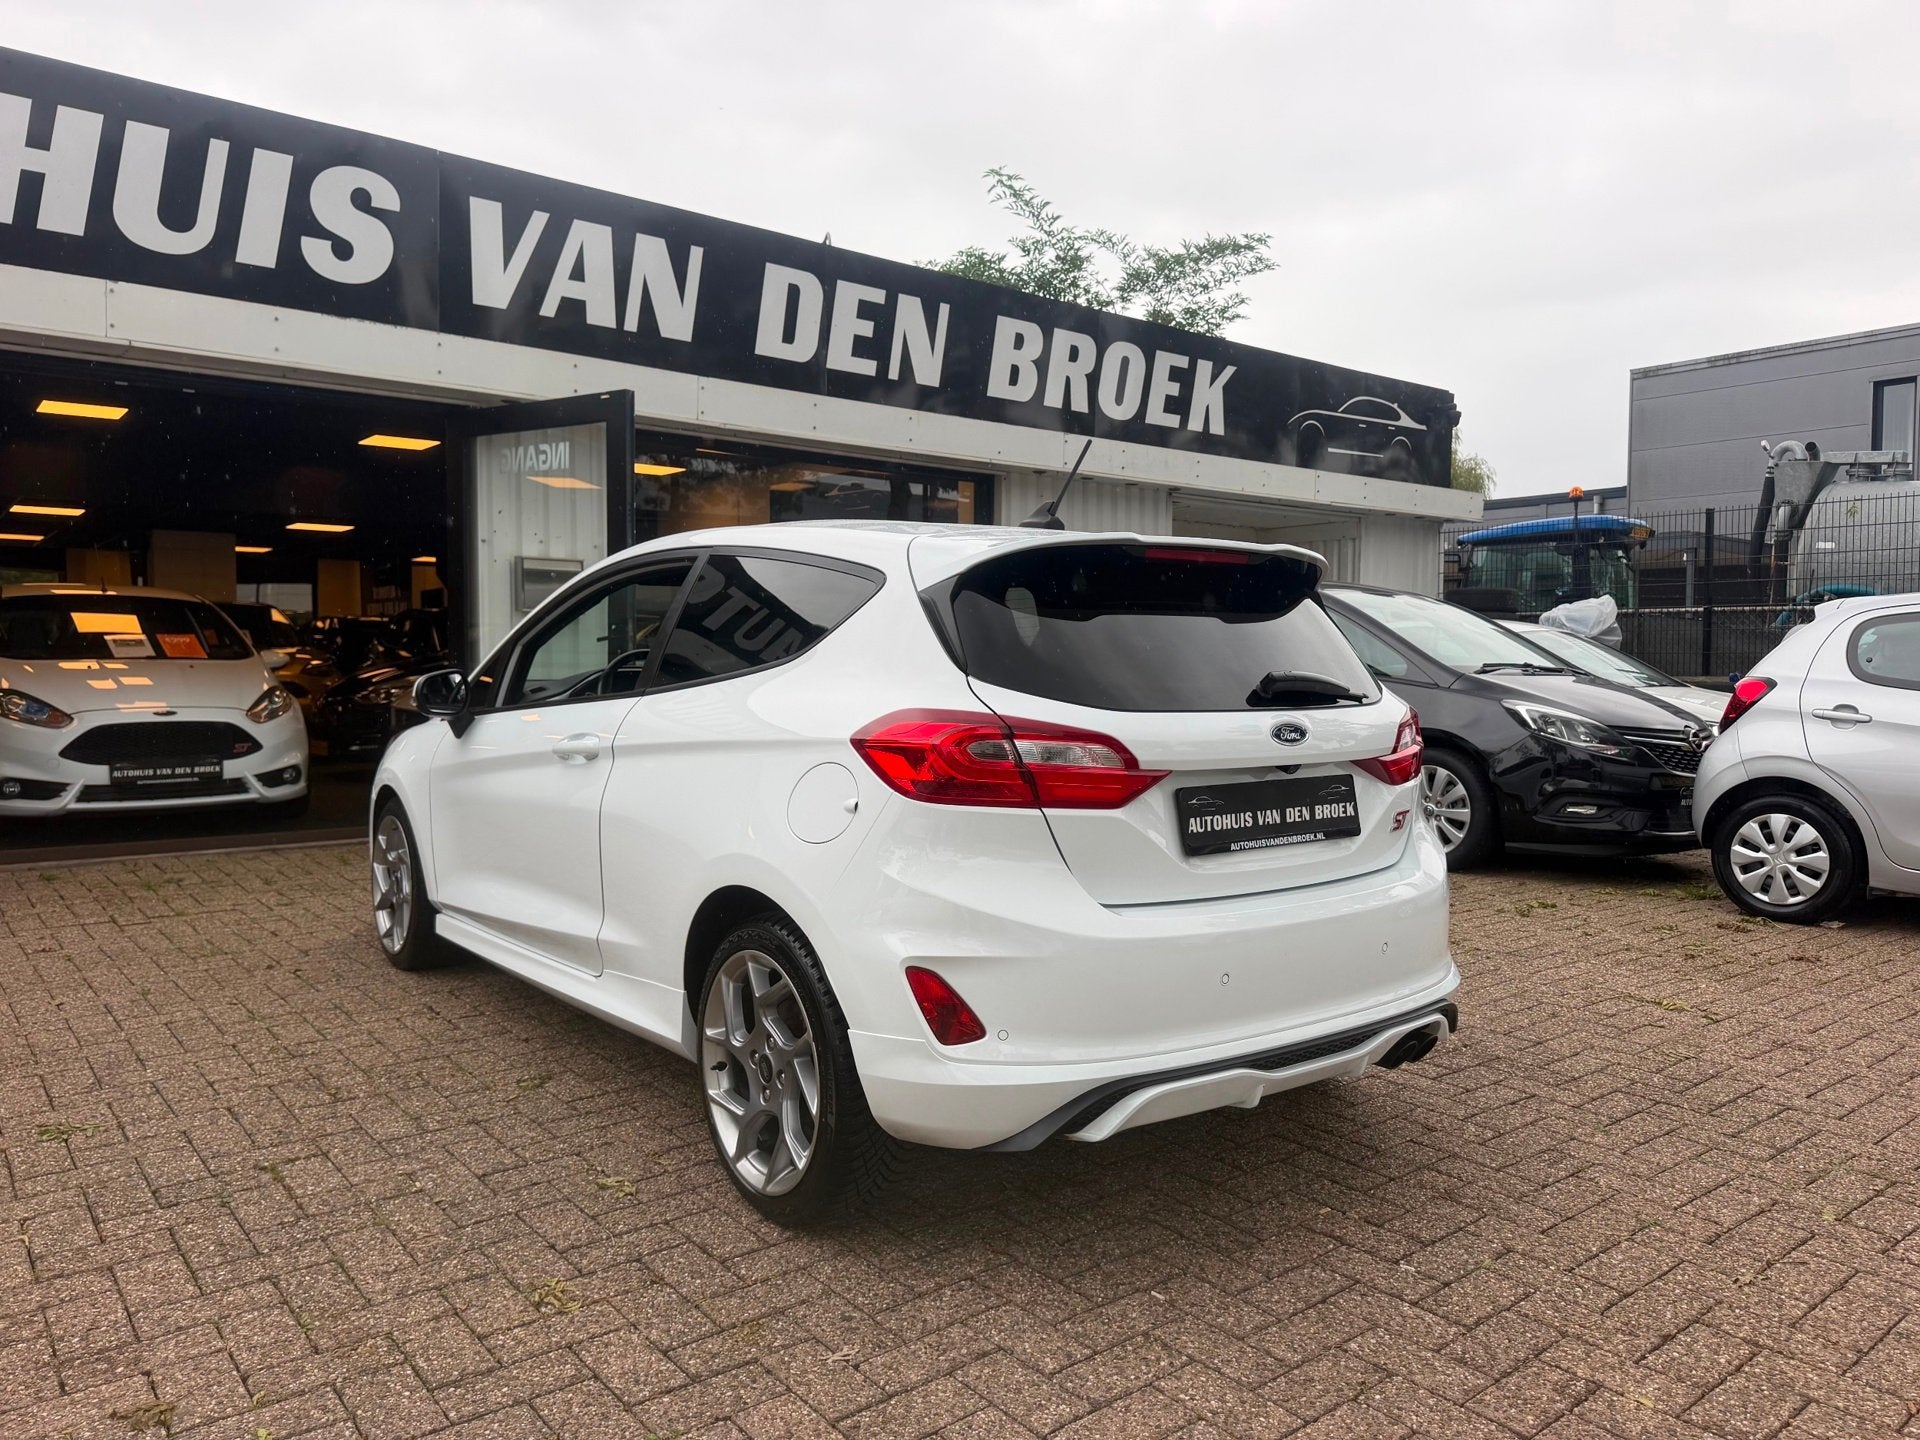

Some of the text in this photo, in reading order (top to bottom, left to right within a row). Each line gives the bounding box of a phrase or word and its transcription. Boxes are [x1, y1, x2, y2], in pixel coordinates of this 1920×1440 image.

[469, 195, 704, 342] VAN
[755, 263, 950, 388] DEN
[987, 315, 1238, 436] BROEK
[1280, 727, 1301, 740] Ford
[112, 768, 154, 777] AUTOHUIS
[156, 767, 172, 775] VAN
[175, 766, 191, 774] DEN
[1188, 802, 1355, 834] AUTOHUIS VAN DEN BROEK
[1390, 809, 1410, 832] ST
[1230, 832, 1326, 851] AUTOHUISVANDENBROEK.NL
